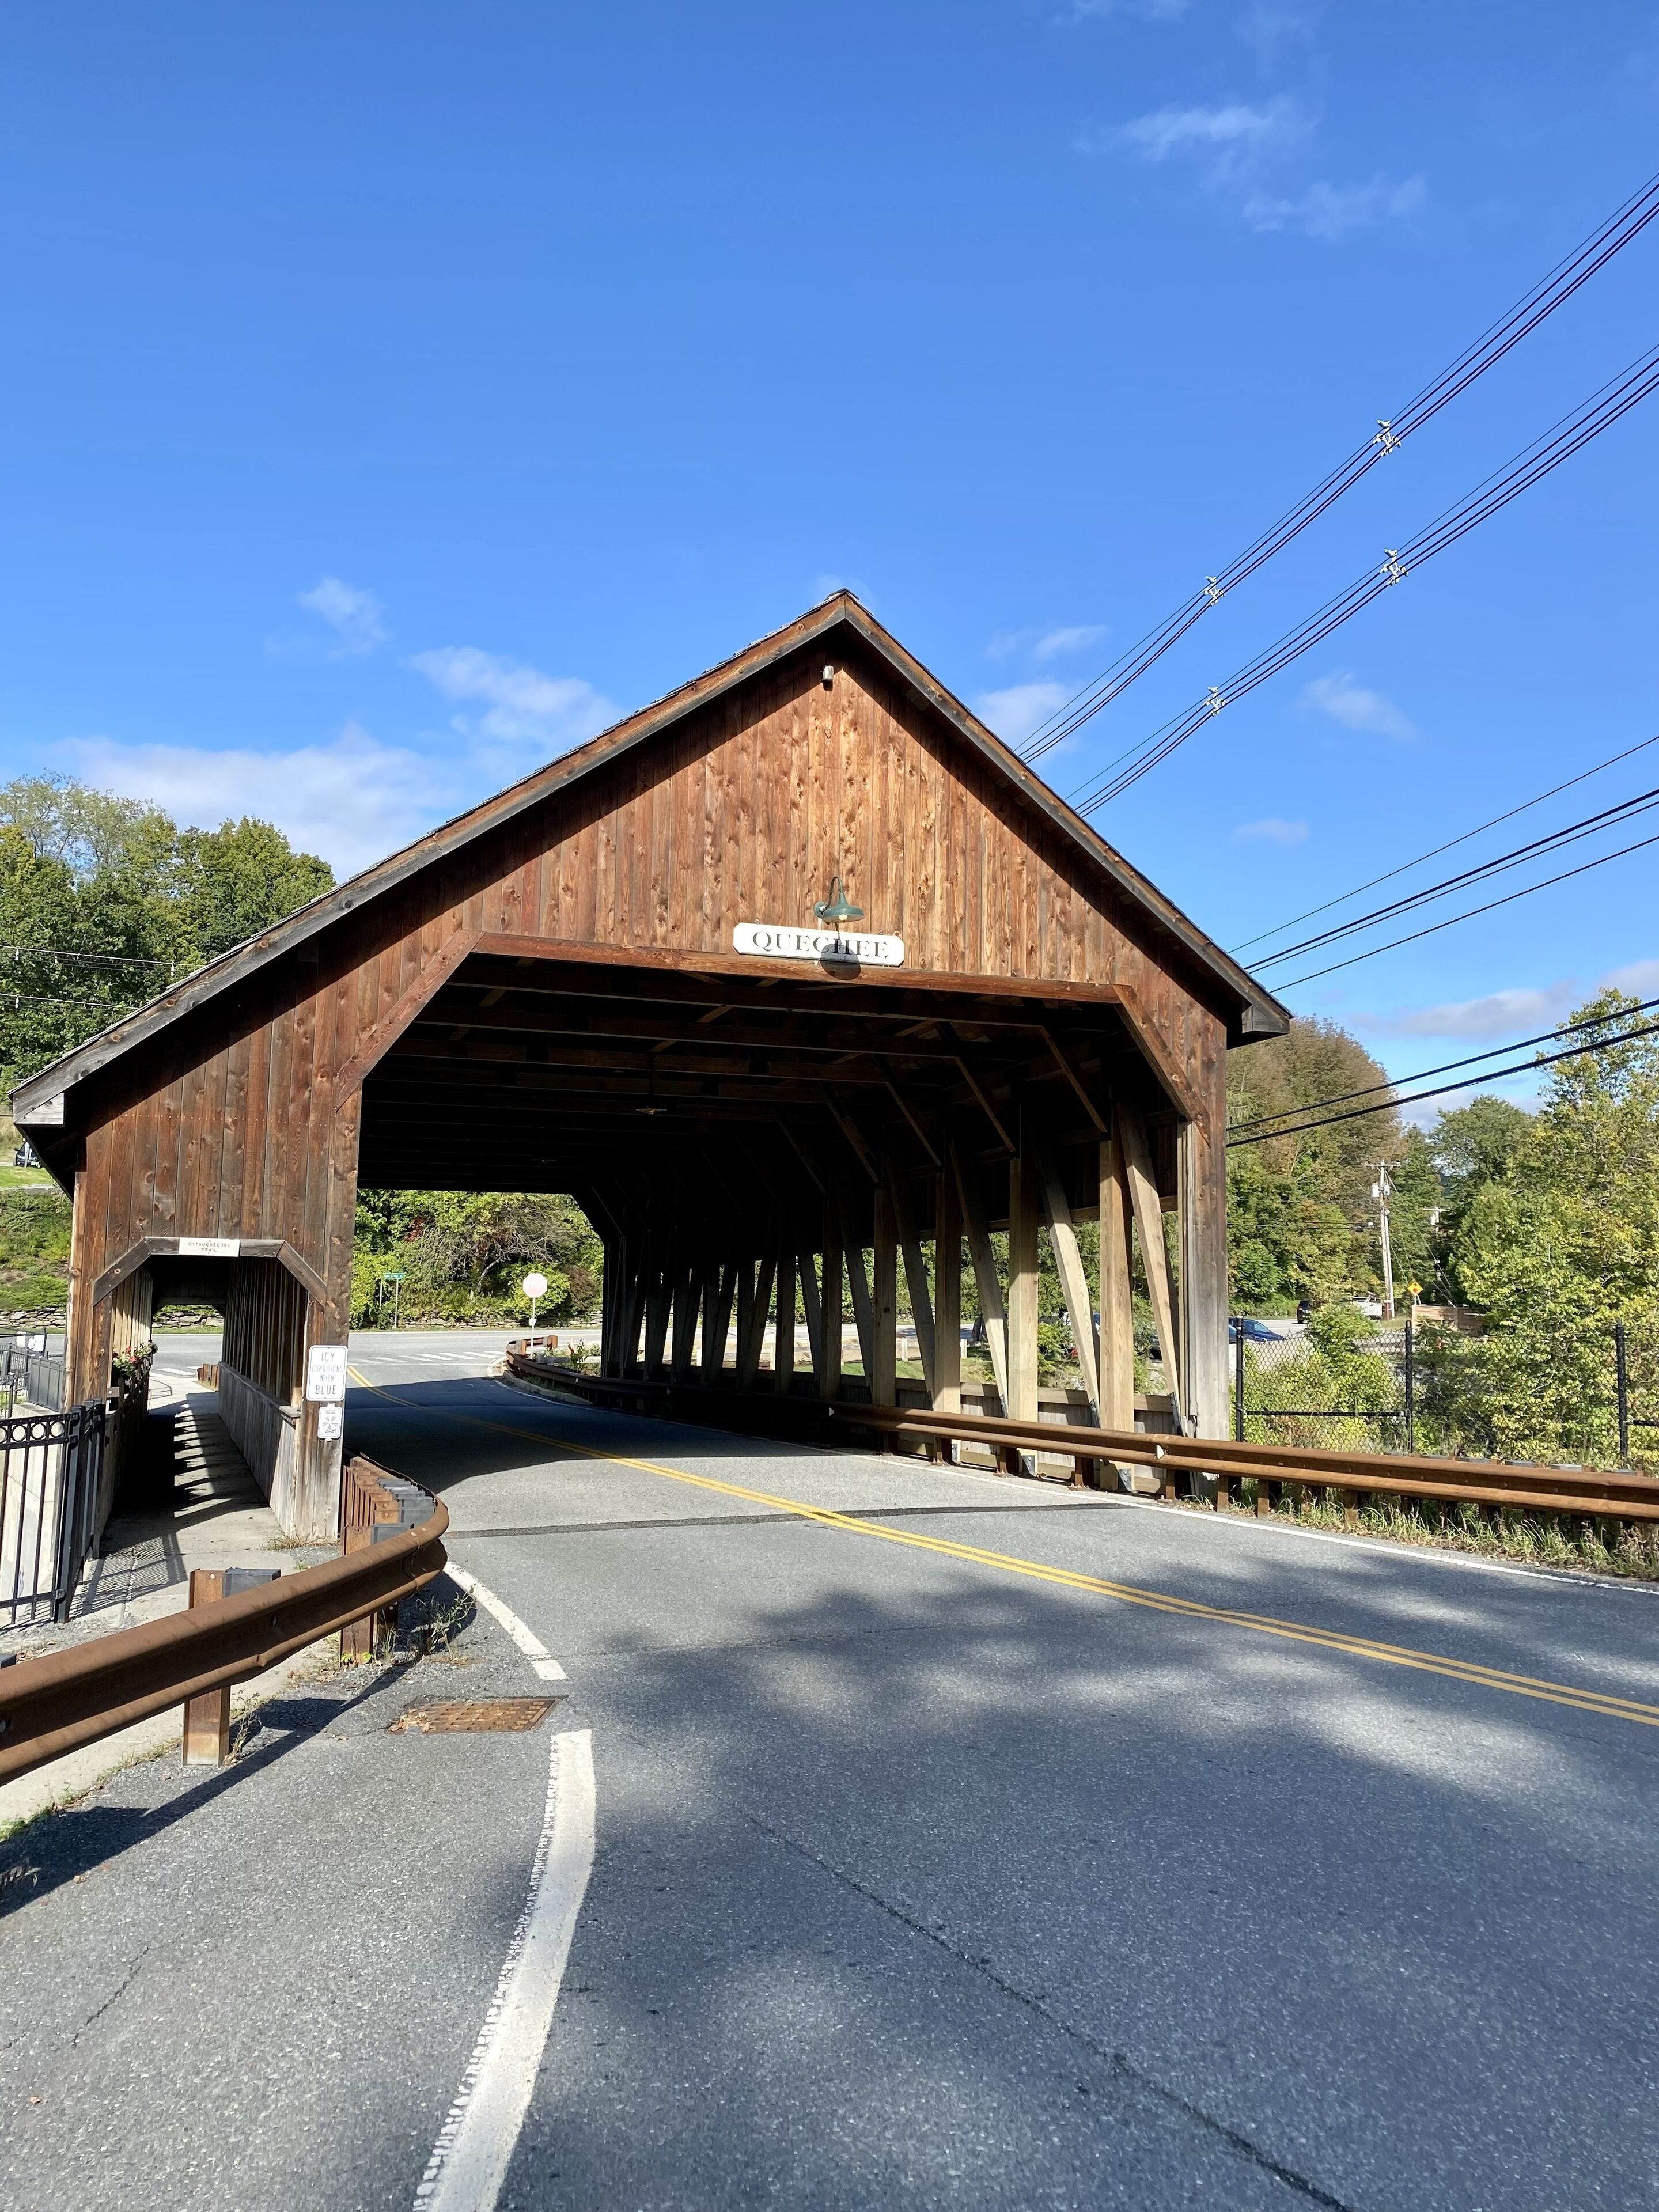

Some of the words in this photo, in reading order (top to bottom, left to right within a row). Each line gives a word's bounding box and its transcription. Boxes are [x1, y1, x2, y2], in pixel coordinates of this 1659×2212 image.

[752, 931, 888, 959] QUECHEE
[321, 1351, 335, 1362] ICY
[312, 1364, 343, 1373] CONDITIONS
[320, 1374, 334, 1382] WHEN
[315, 1384, 336, 1395] BLUE
